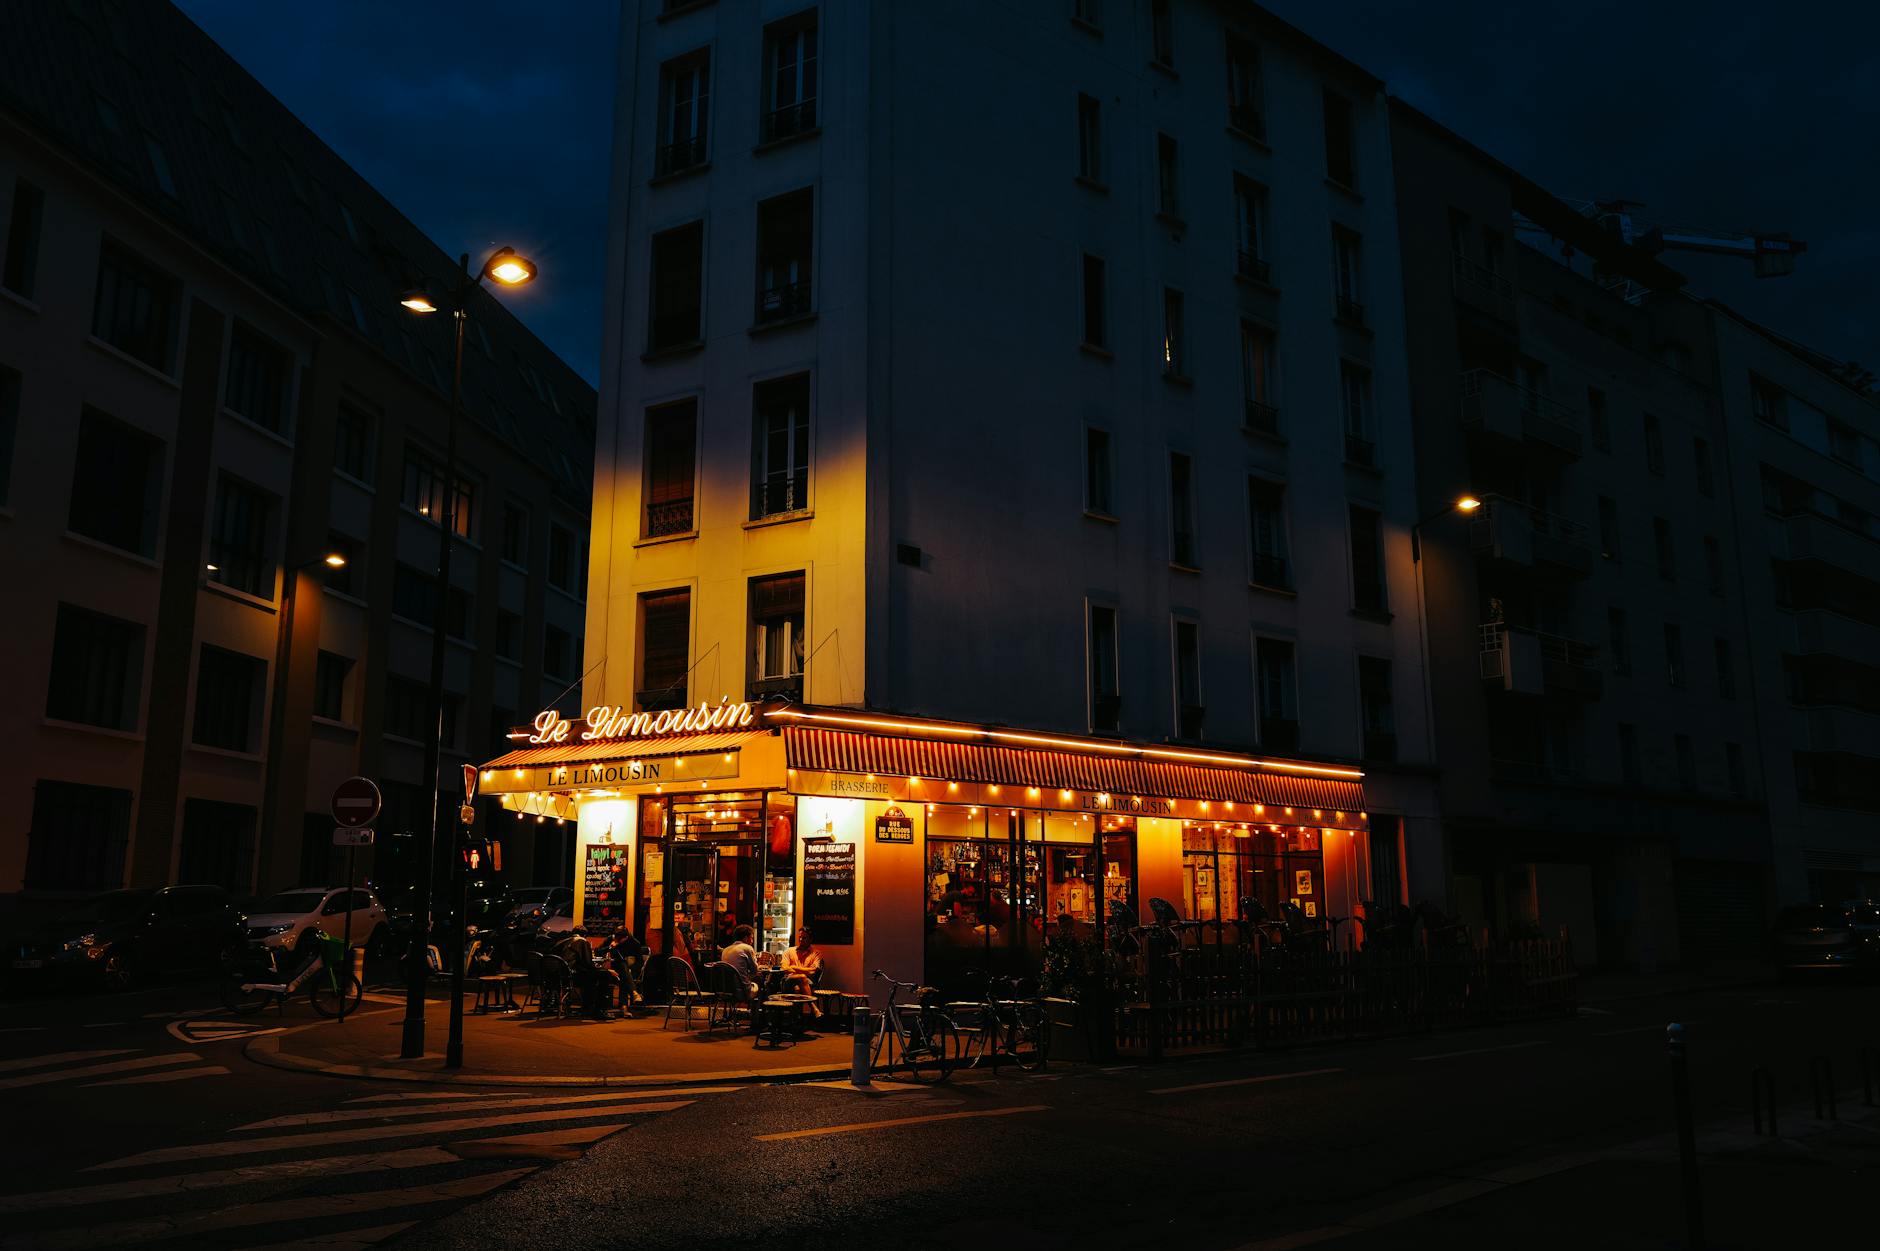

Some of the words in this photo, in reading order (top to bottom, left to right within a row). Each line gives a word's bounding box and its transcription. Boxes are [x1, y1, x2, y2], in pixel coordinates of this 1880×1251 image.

[529, 710, 569, 743] Le
[581, 696, 753, 740] Limousin
[547, 771, 567, 786] LE
[573, 763, 661, 783] LIMOUSIN
[831, 780, 889, 793] BRASSERIE
[1082, 796, 1099, 809] LE
[1105, 798, 1171, 814] LIMOUSIN
